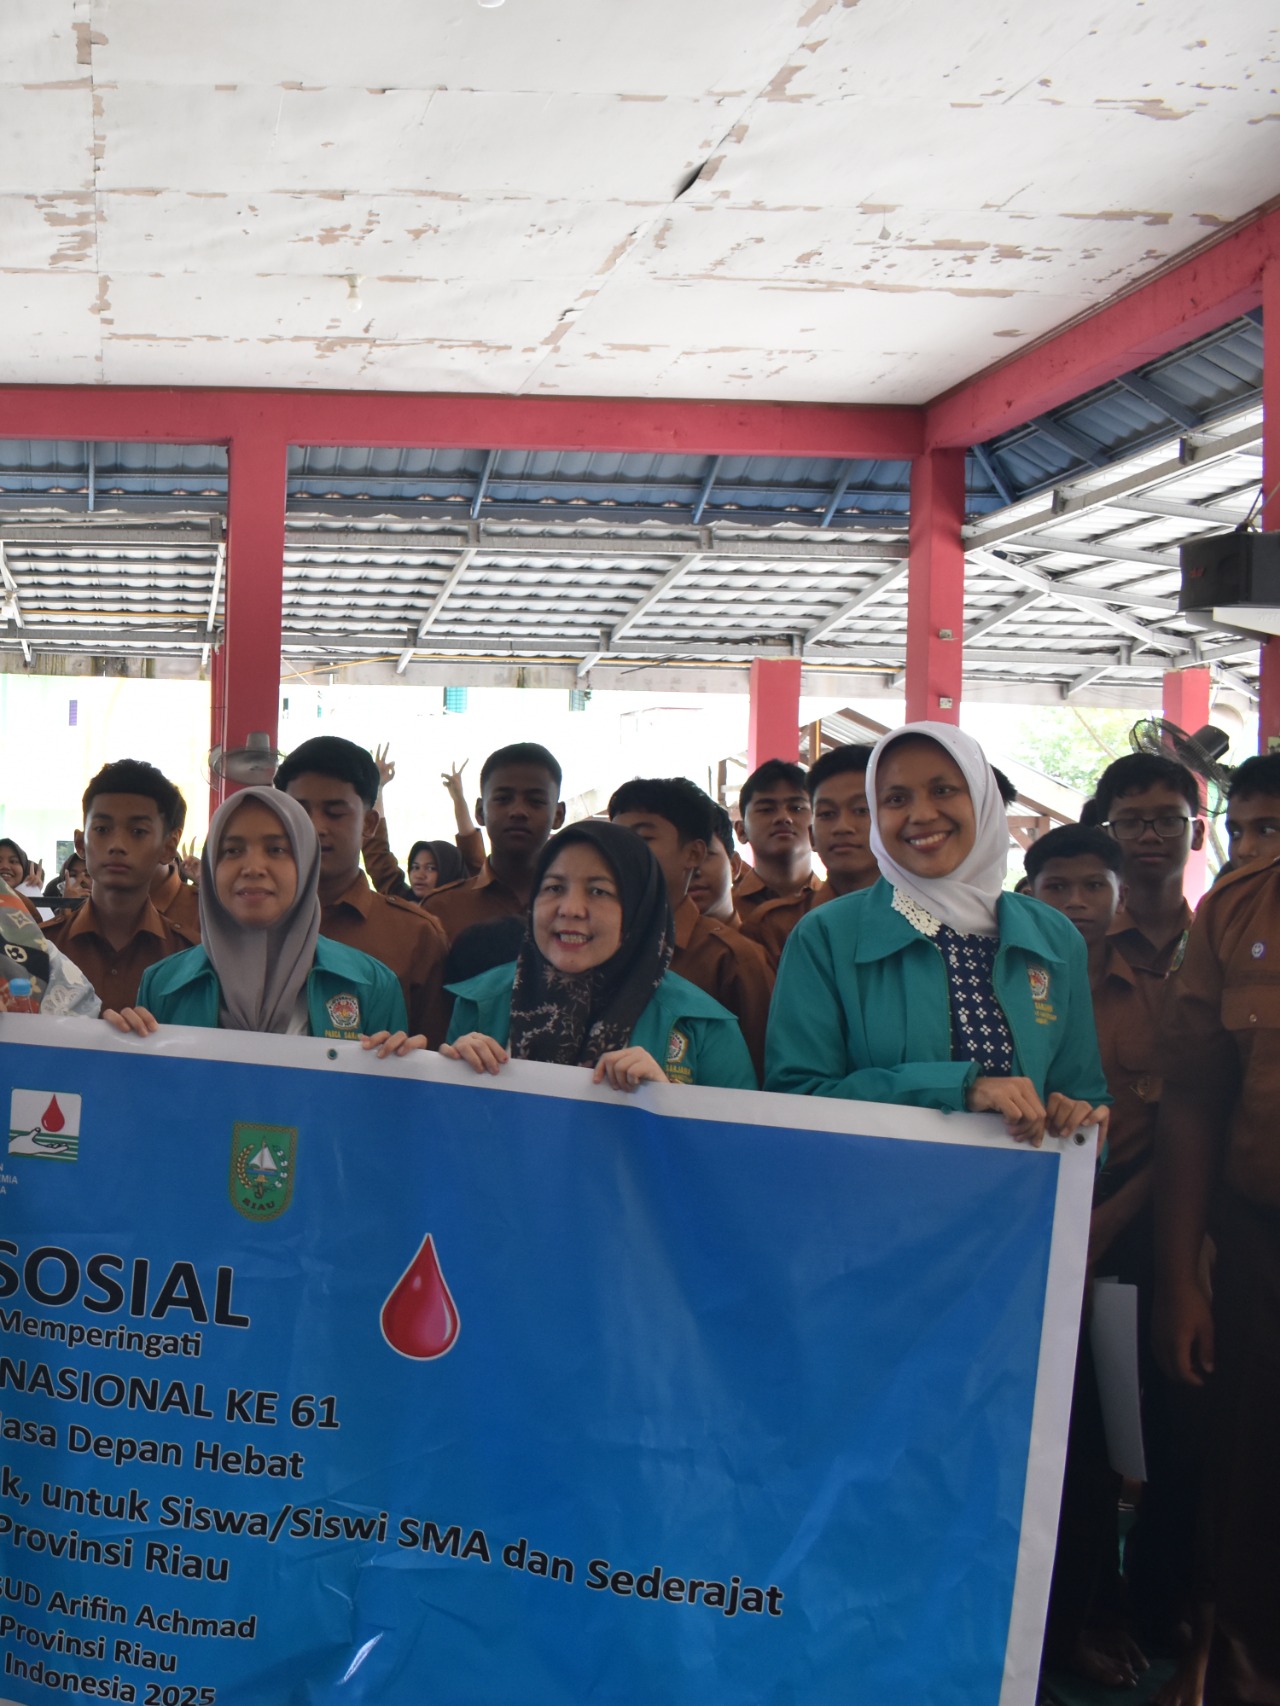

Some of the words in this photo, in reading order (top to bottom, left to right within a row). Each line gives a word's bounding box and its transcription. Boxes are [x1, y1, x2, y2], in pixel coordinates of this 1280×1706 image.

[226, 1389, 278, 1424] KE
[291, 1395, 339, 1428] 61
[68, 1430, 182, 1466] Depan
[195, 1443, 304, 1478] Hebat
[42, 1483, 149, 1522] untuk
[160, 1496, 388, 1542] Siswa/Siswi
[398, 1519, 490, 1562] SMA
[503, 1538, 574, 1583] dan
[586, 1560, 783, 1616] Sederajat
[145, 1542, 229, 1581] Riau
[47, 1591, 127, 1623] Arifin
[135, 1605, 256, 1638] Achmad
[0, 1615, 106, 1660] Provinsi
[114, 1640, 176, 1672] Riau
[5, 1651, 136, 1703] Indonesia
[144, 1683, 217, 1706] 2025
